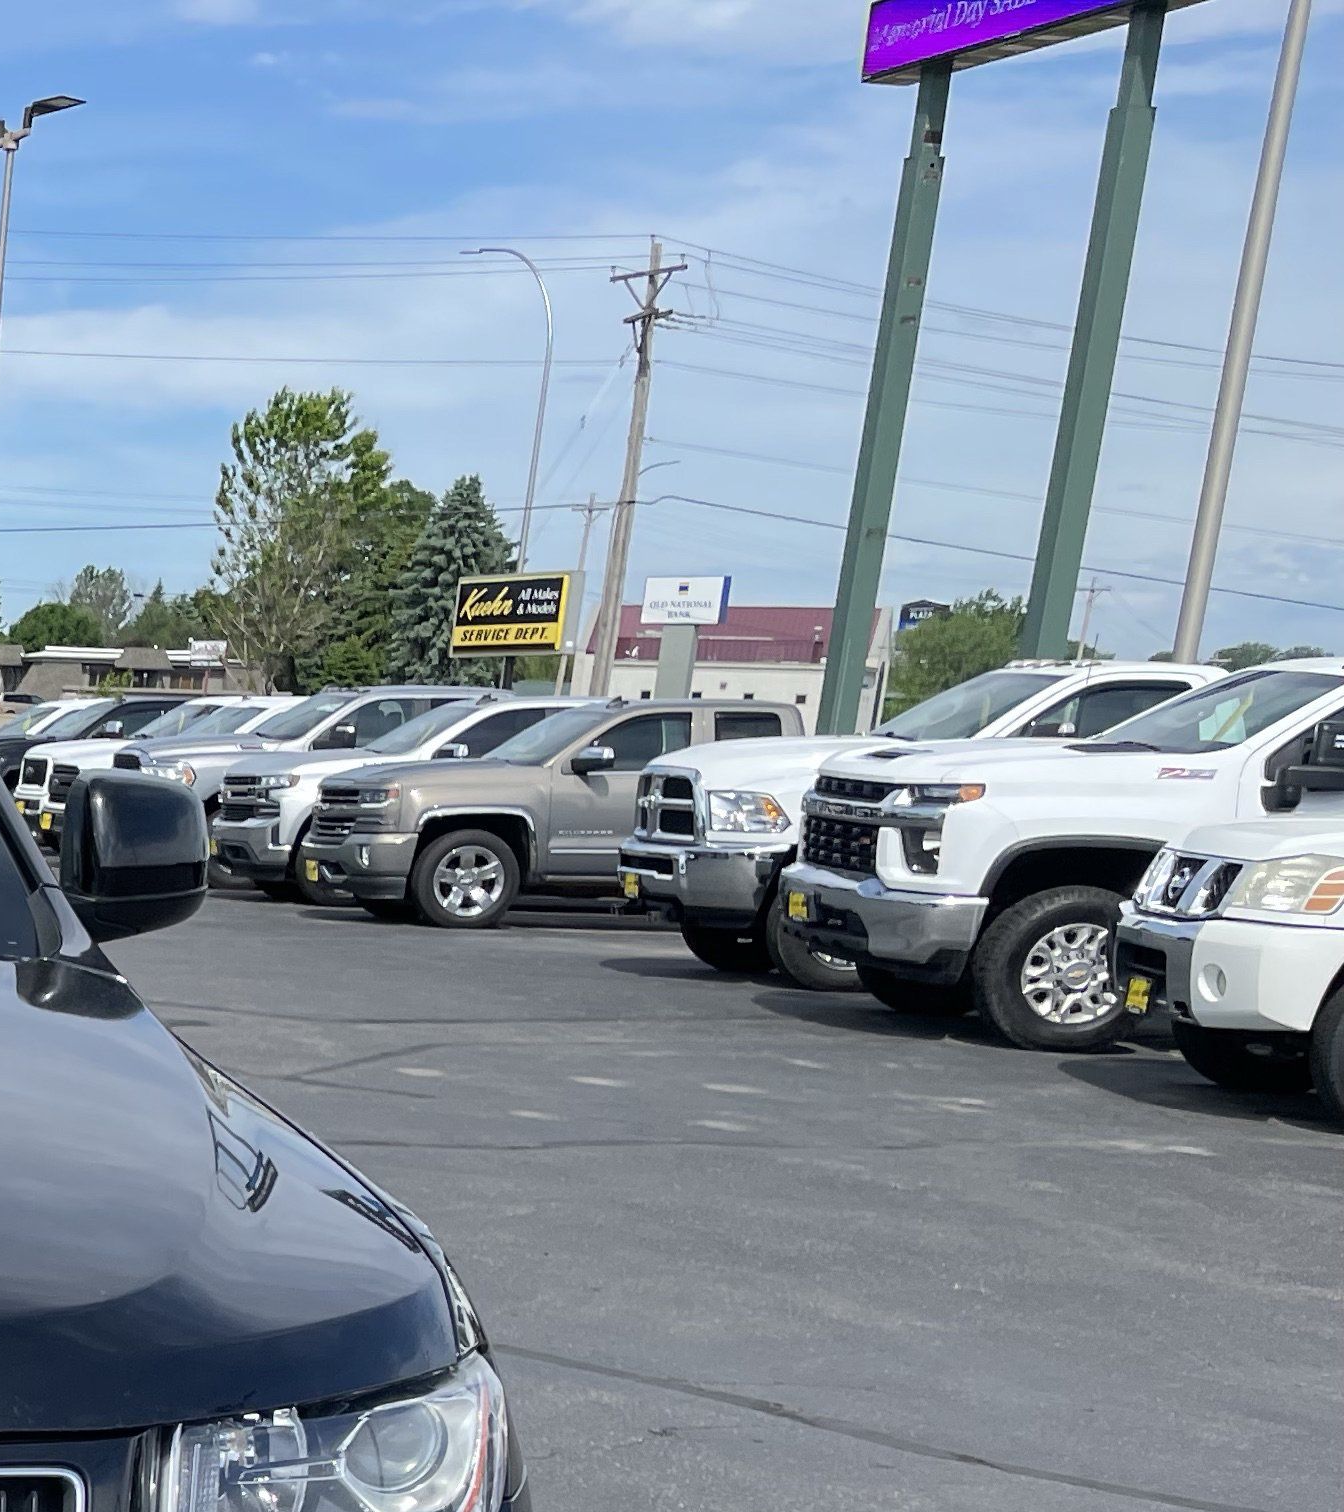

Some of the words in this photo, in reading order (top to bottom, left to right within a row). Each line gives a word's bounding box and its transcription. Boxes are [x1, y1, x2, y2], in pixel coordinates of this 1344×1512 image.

[954, 0, 987, 28] Day
[990, 0, 1036, 16] SA
[518, 588, 532, 601] All
[532, 587, 560, 600] Makes
[459, 586, 514, 621] Kuehn
[516, 603, 524, 616] &
[525, 602, 557, 615] Models
[649, 601, 669, 610] OLD
[670, 600, 713, 609] NATIONAL
[667, 611, 691, 619] BANK
[460, 627, 511, 642] SERVICE
